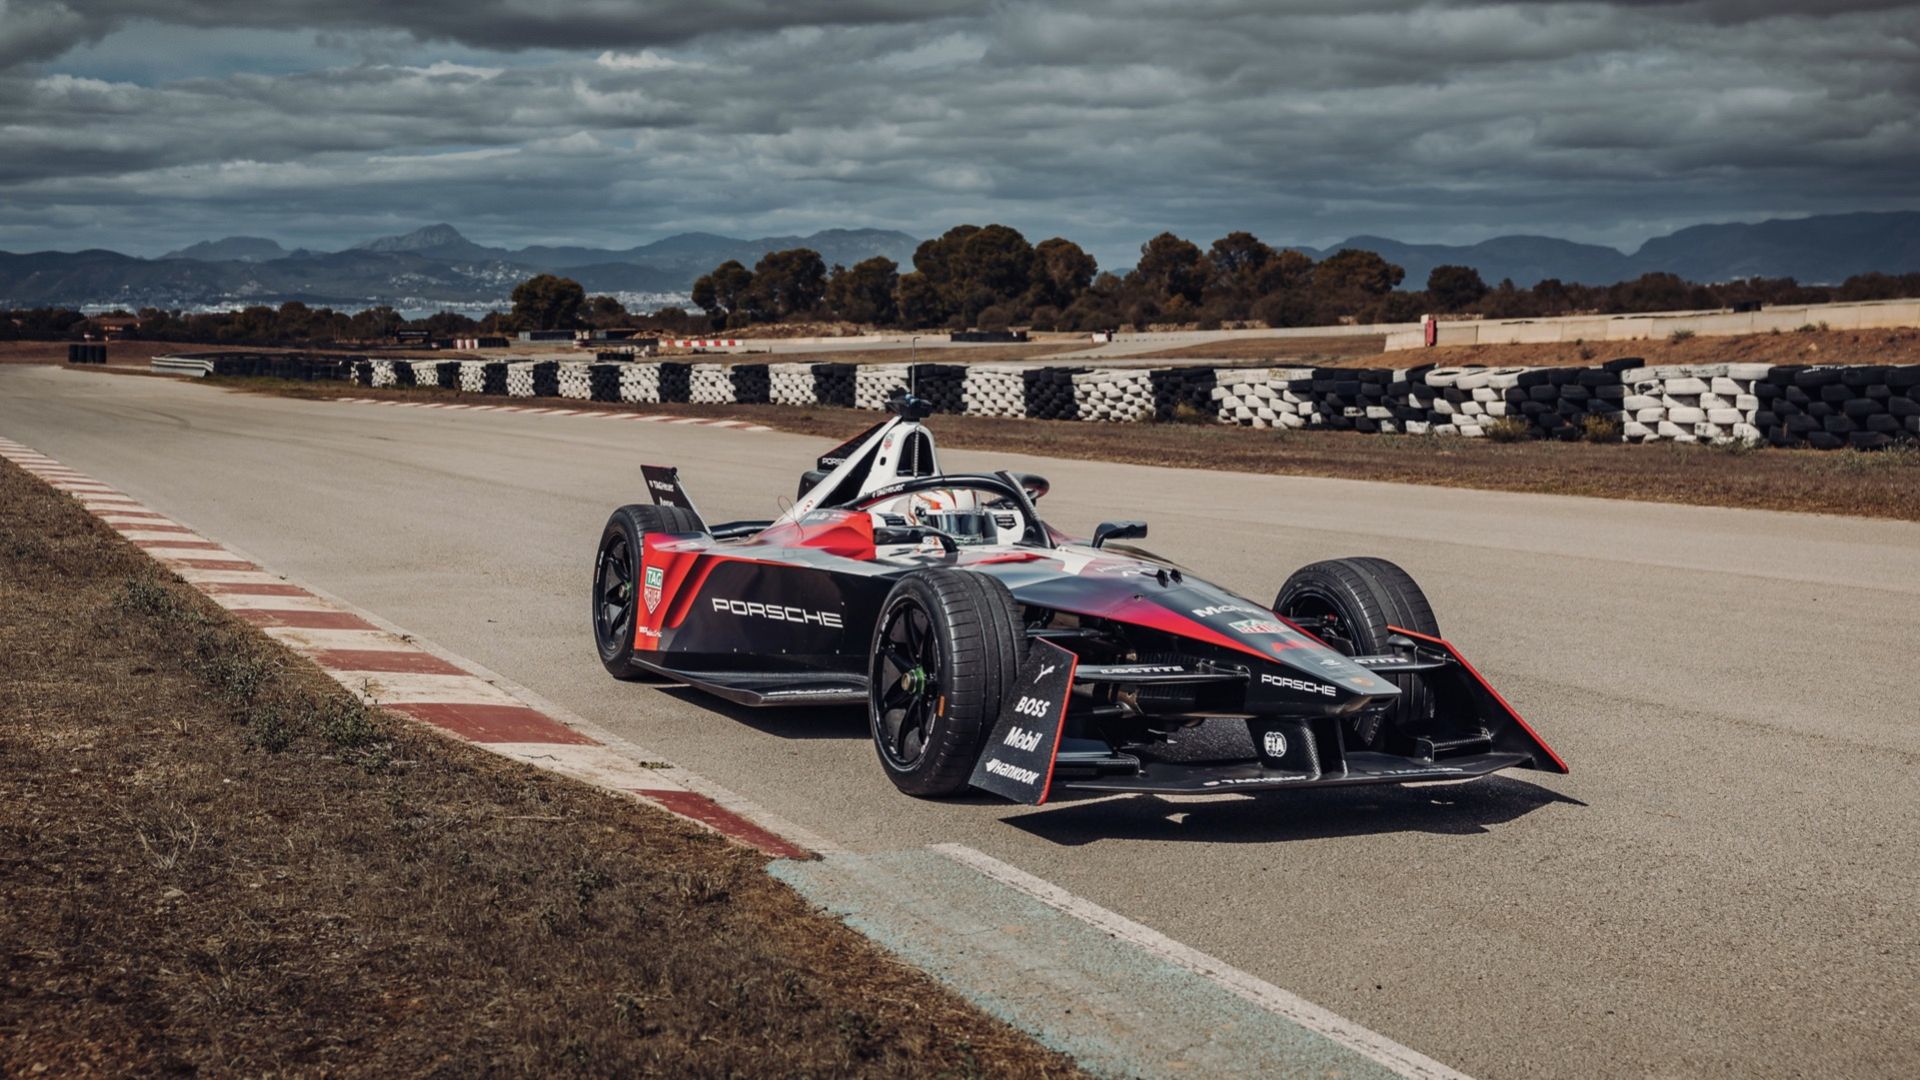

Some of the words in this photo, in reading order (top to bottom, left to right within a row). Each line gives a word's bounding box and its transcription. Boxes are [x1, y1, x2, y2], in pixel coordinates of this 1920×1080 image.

[647, 569, 662, 587] TAG
[712, 598, 844, 628] PORSCHE
[1100, 666, 1184, 674] LOCTITE
[1261, 674, 1337, 697] PORSCHE
[1015, 696, 1051, 718] BOSS
[1003, 726, 1043, 753] Mobil
